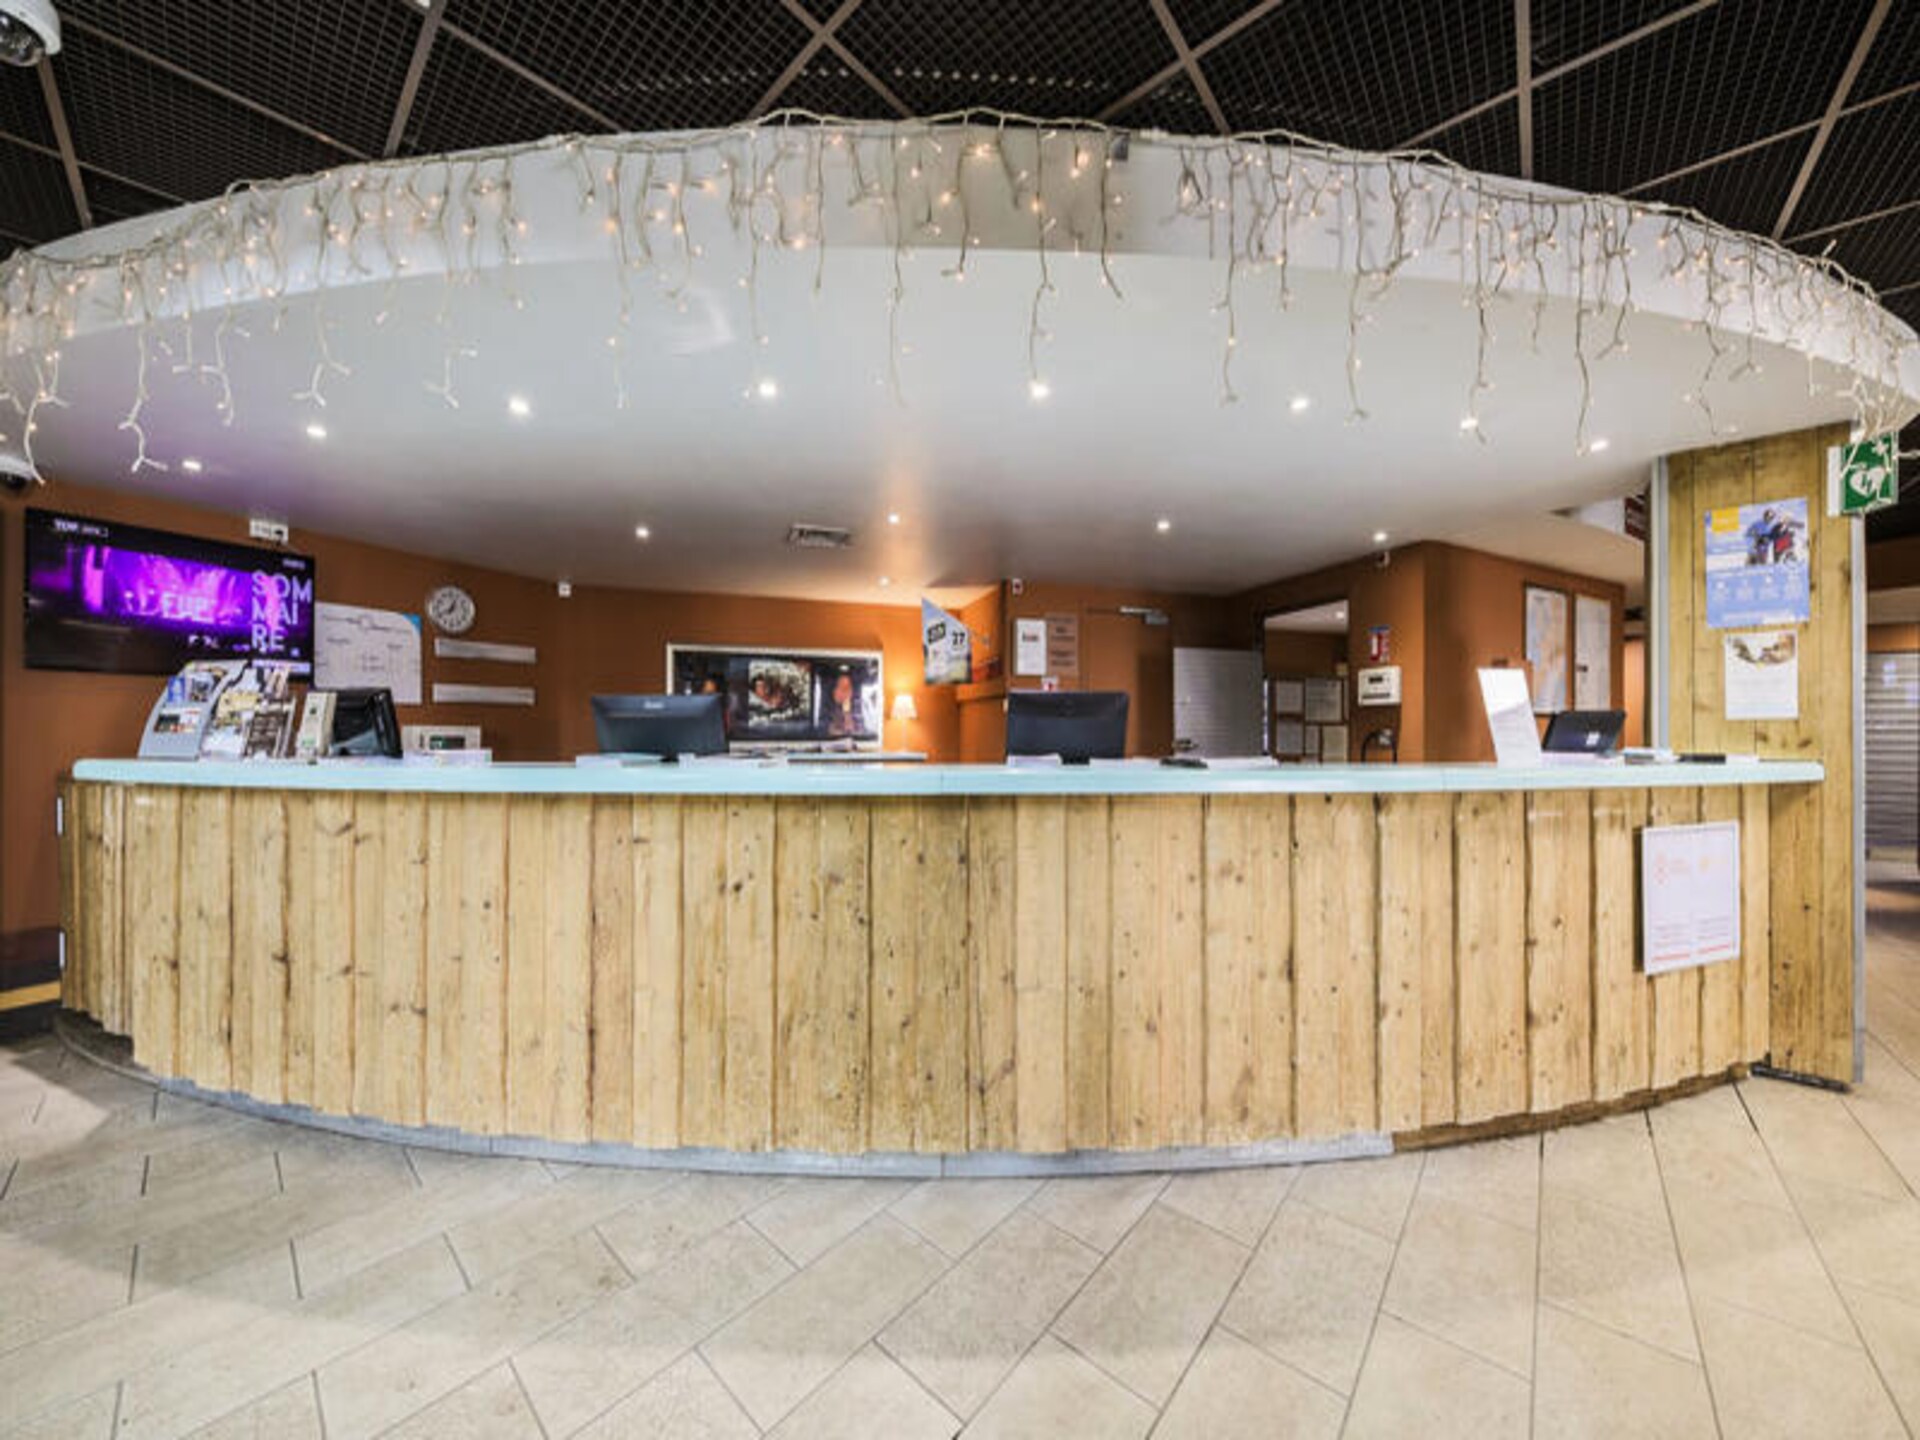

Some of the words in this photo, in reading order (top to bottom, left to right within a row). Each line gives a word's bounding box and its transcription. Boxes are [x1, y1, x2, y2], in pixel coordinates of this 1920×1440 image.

[252, 570, 312, 603] SOM
[252, 596, 298, 625] MAI
[252, 623, 285, 651] RE
